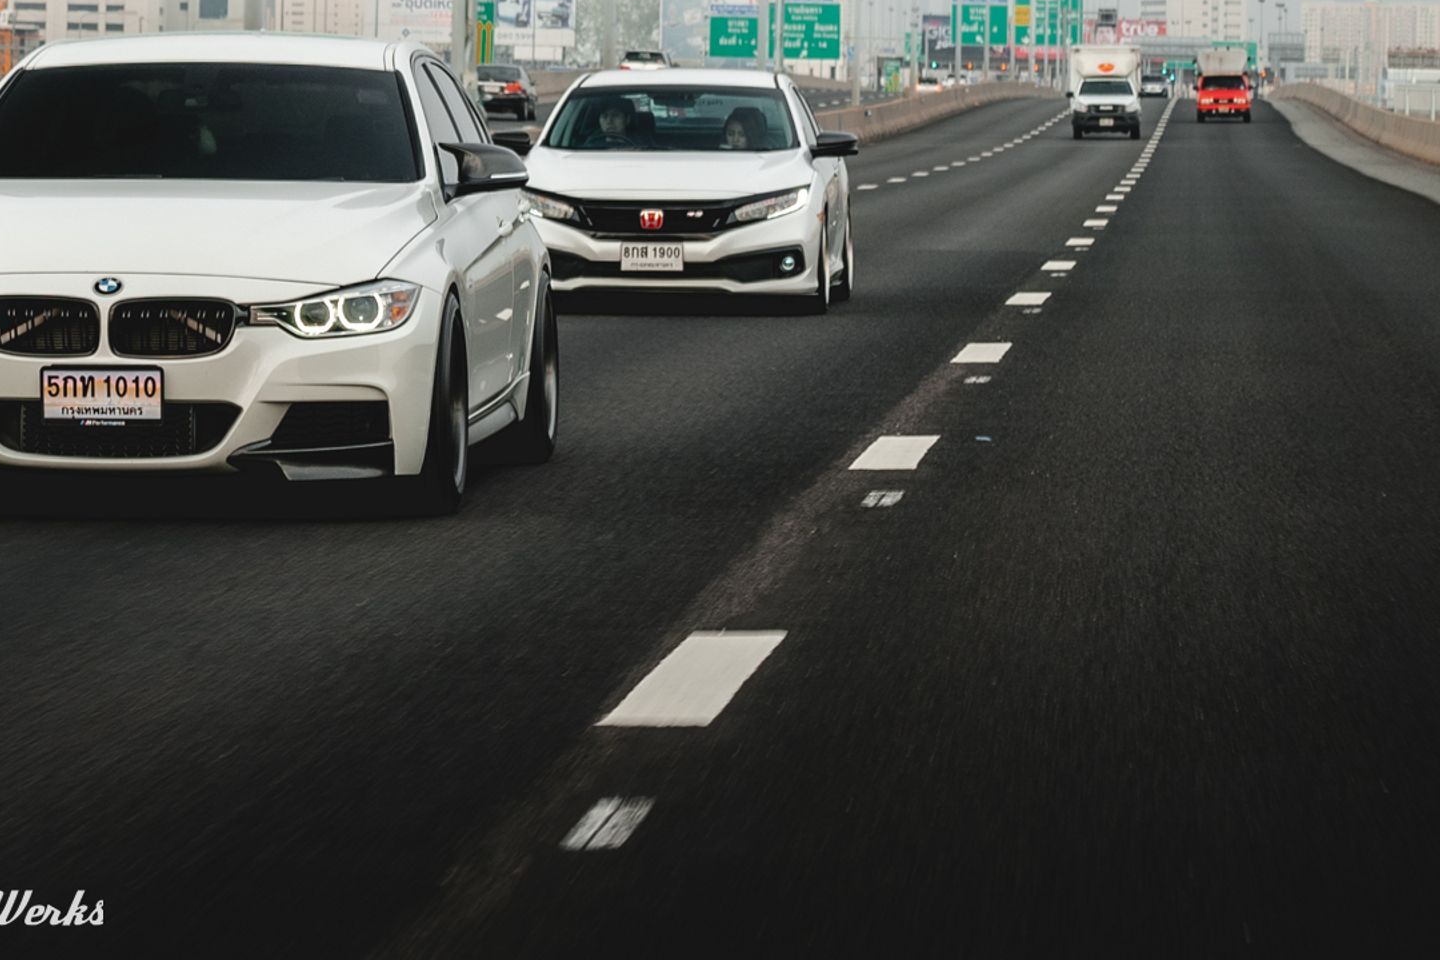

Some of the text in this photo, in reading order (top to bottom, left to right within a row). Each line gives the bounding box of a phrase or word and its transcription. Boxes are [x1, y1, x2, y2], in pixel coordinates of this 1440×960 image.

[653, 246, 680, 259] 1900
[47, 375, 157, 398] 5กท 1010
[61, 405, 144, 420] กรุงเทพมหานคร
